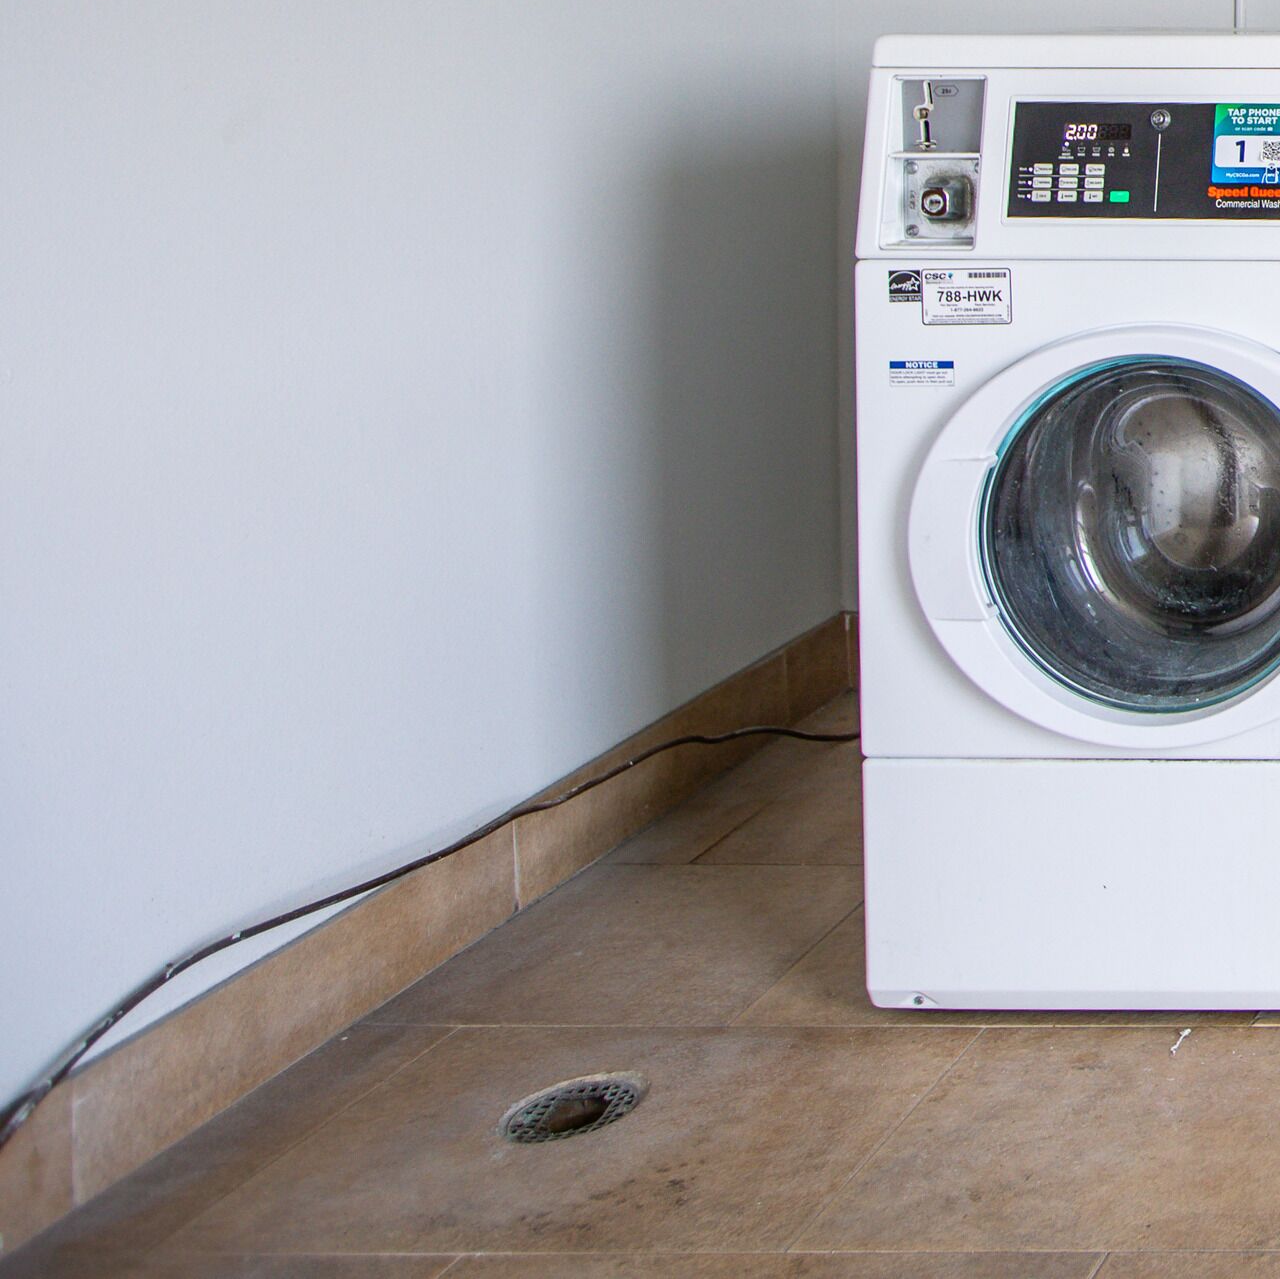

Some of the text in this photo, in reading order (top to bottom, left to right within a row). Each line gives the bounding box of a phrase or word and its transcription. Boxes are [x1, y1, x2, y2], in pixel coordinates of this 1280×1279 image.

[1065, 124, 1098, 140] 2.00
[1235, 140, 1245, 162] 1
[1208, 186, 1248, 199] Speed
[1215, 199, 1260, 208] Commercial
[924, 272, 947, 280] CSC
[937, 290, 1002, 302] 788-HWK
